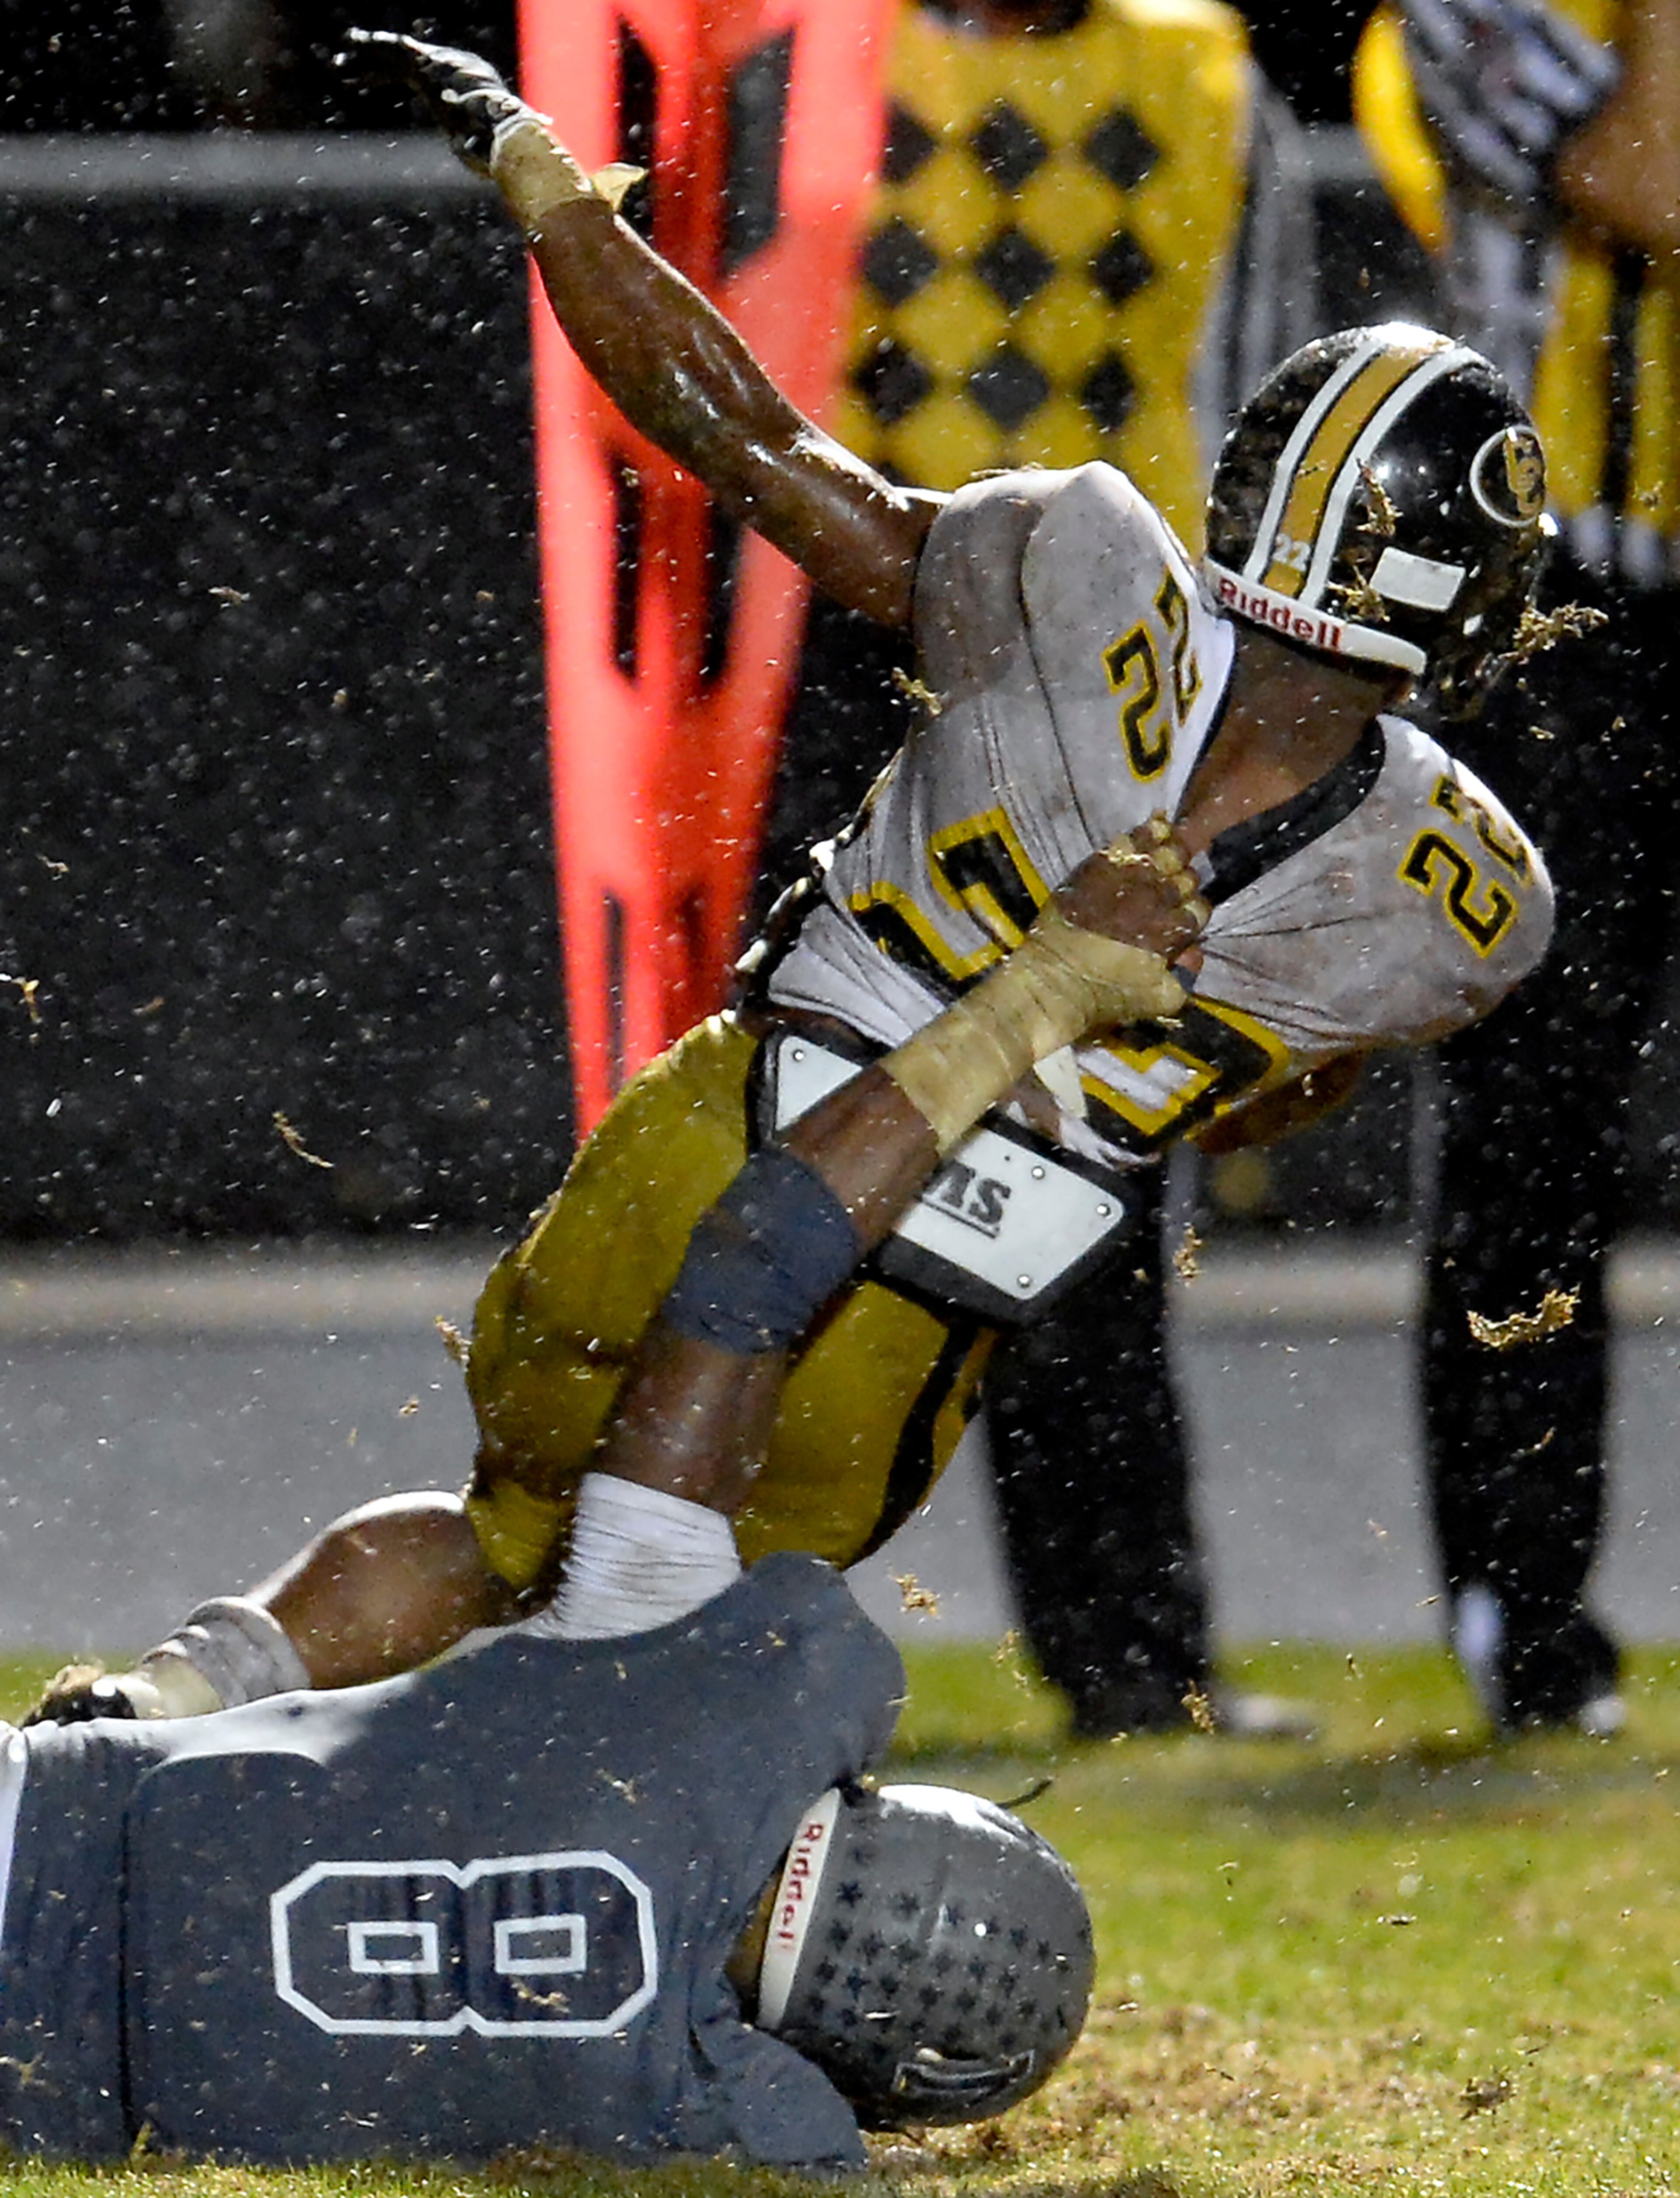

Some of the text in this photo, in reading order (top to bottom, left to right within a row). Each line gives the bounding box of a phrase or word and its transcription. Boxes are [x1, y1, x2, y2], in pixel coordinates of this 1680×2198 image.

[1219, 576, 1341, 649] Riddell
[1272, 533, 1311, 572] 22
[1101, 565, 1203, 783] 22
[270, 1850, 658, 2037] 8
